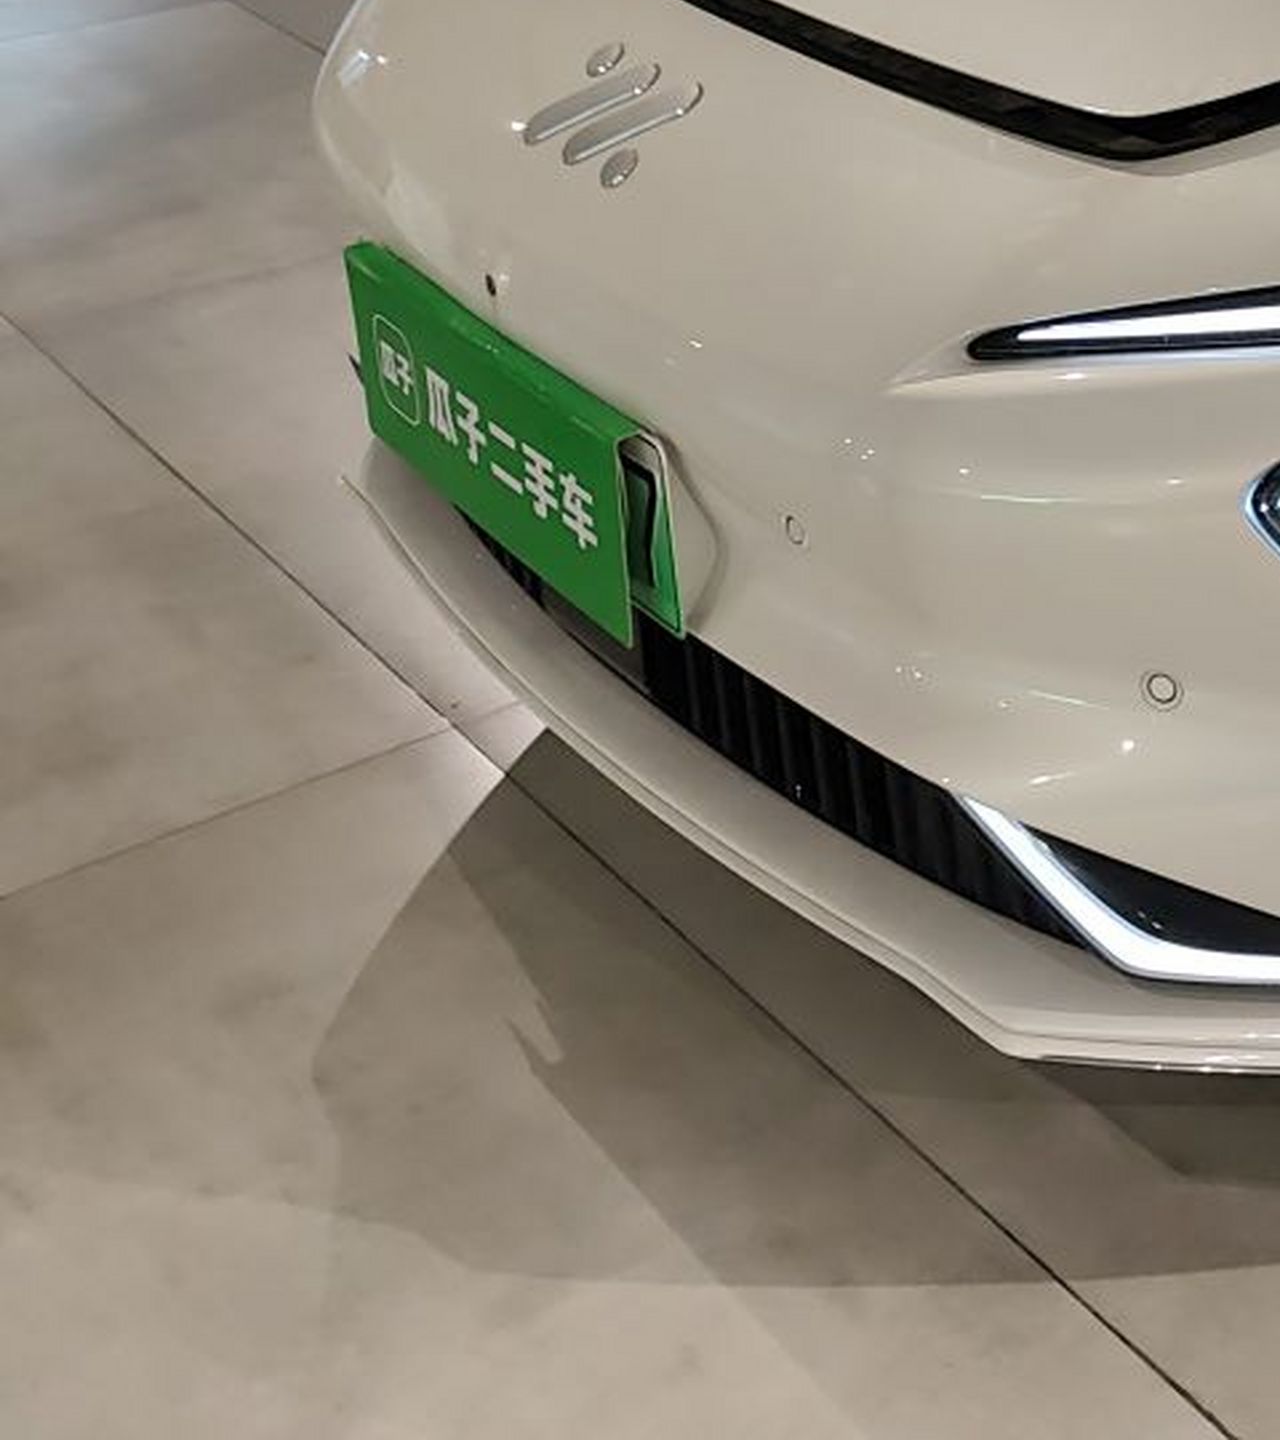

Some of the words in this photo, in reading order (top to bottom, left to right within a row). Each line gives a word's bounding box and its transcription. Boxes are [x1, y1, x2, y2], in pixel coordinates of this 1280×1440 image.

[425, 366, 598, 550] 瓜子二手车
